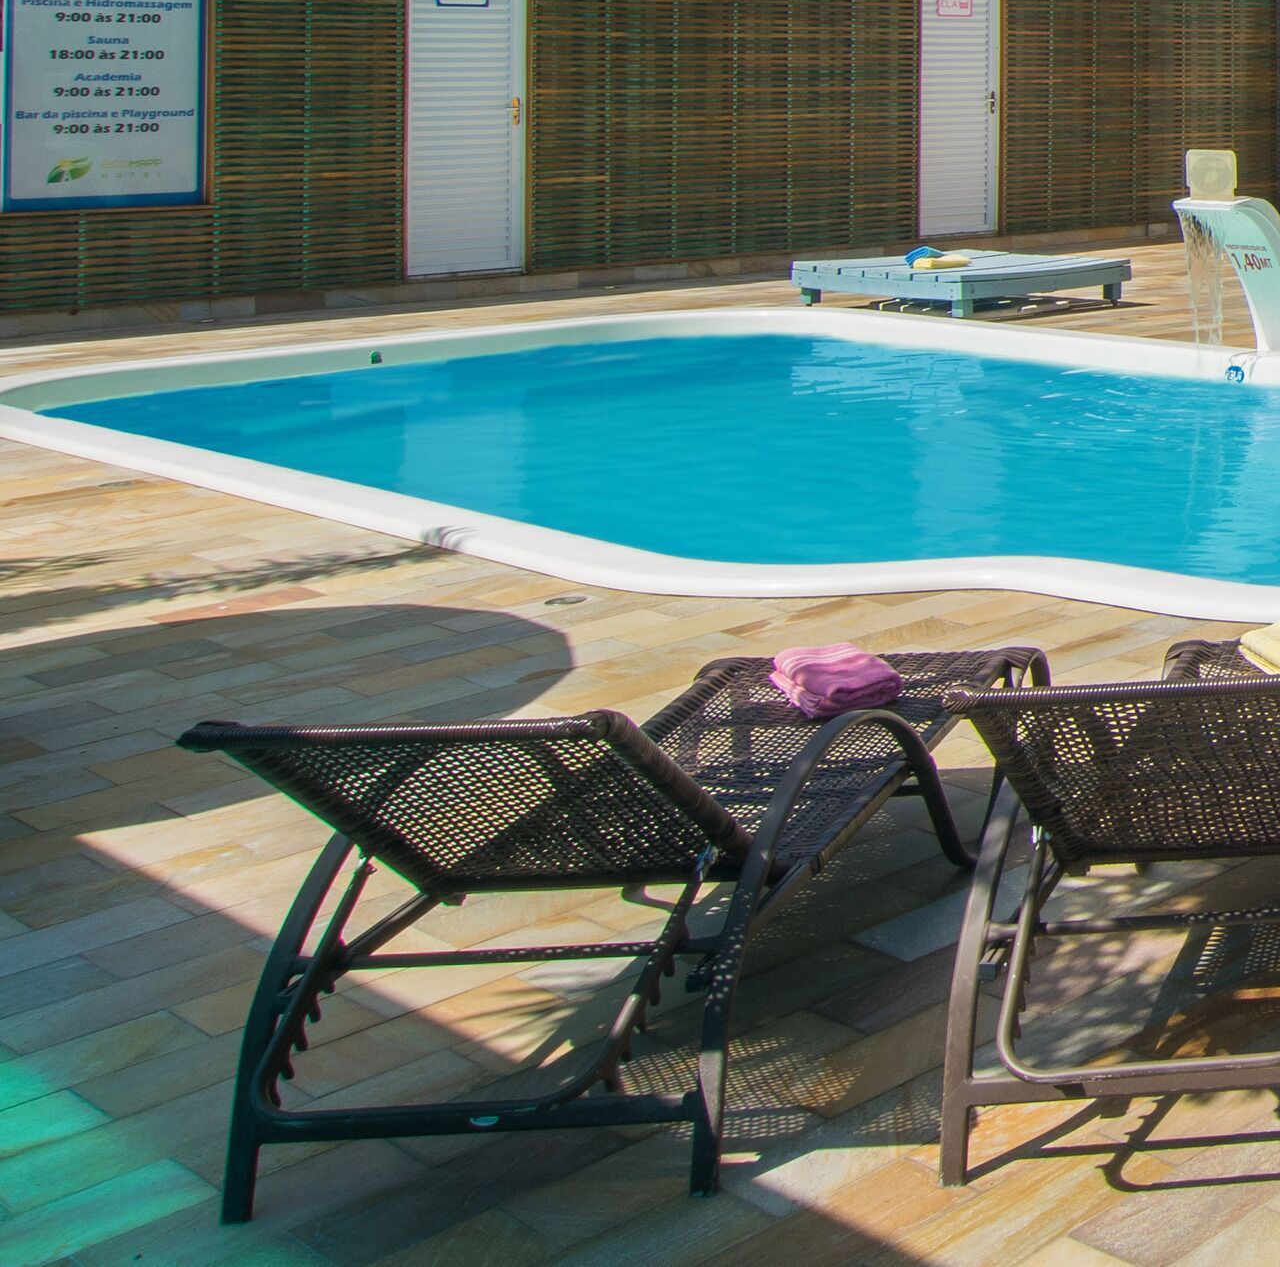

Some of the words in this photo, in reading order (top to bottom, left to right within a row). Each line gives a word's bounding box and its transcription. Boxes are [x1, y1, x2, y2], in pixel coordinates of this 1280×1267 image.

[55, 12, 91, 22] 9:00
[95, 13, 111, 23] às
[116, 13, 161, 23] 21:00
[88, 35, 129, 45] Sauna
[50, 50, 94, 60] 18:00
[99, 50, 116, 60] às
[120, 50, 164, 60] 21:00
[75, 73, 141, 82] Academia
[54, 87, 90, 97] 9:00
[94, 86, 111, 97] às
[115, 87, 160, 96] 21:00
[16, 110, 40, 119] Bar
[42, 110, 58, 119] da
[62, 110, 108, 121] piscina
[122, 108, 194, 120] Playground
[54, 124, 89, 134] 9:00
[93, 123, 110, 133] às
[115, 123, 159, 133] 21:00
